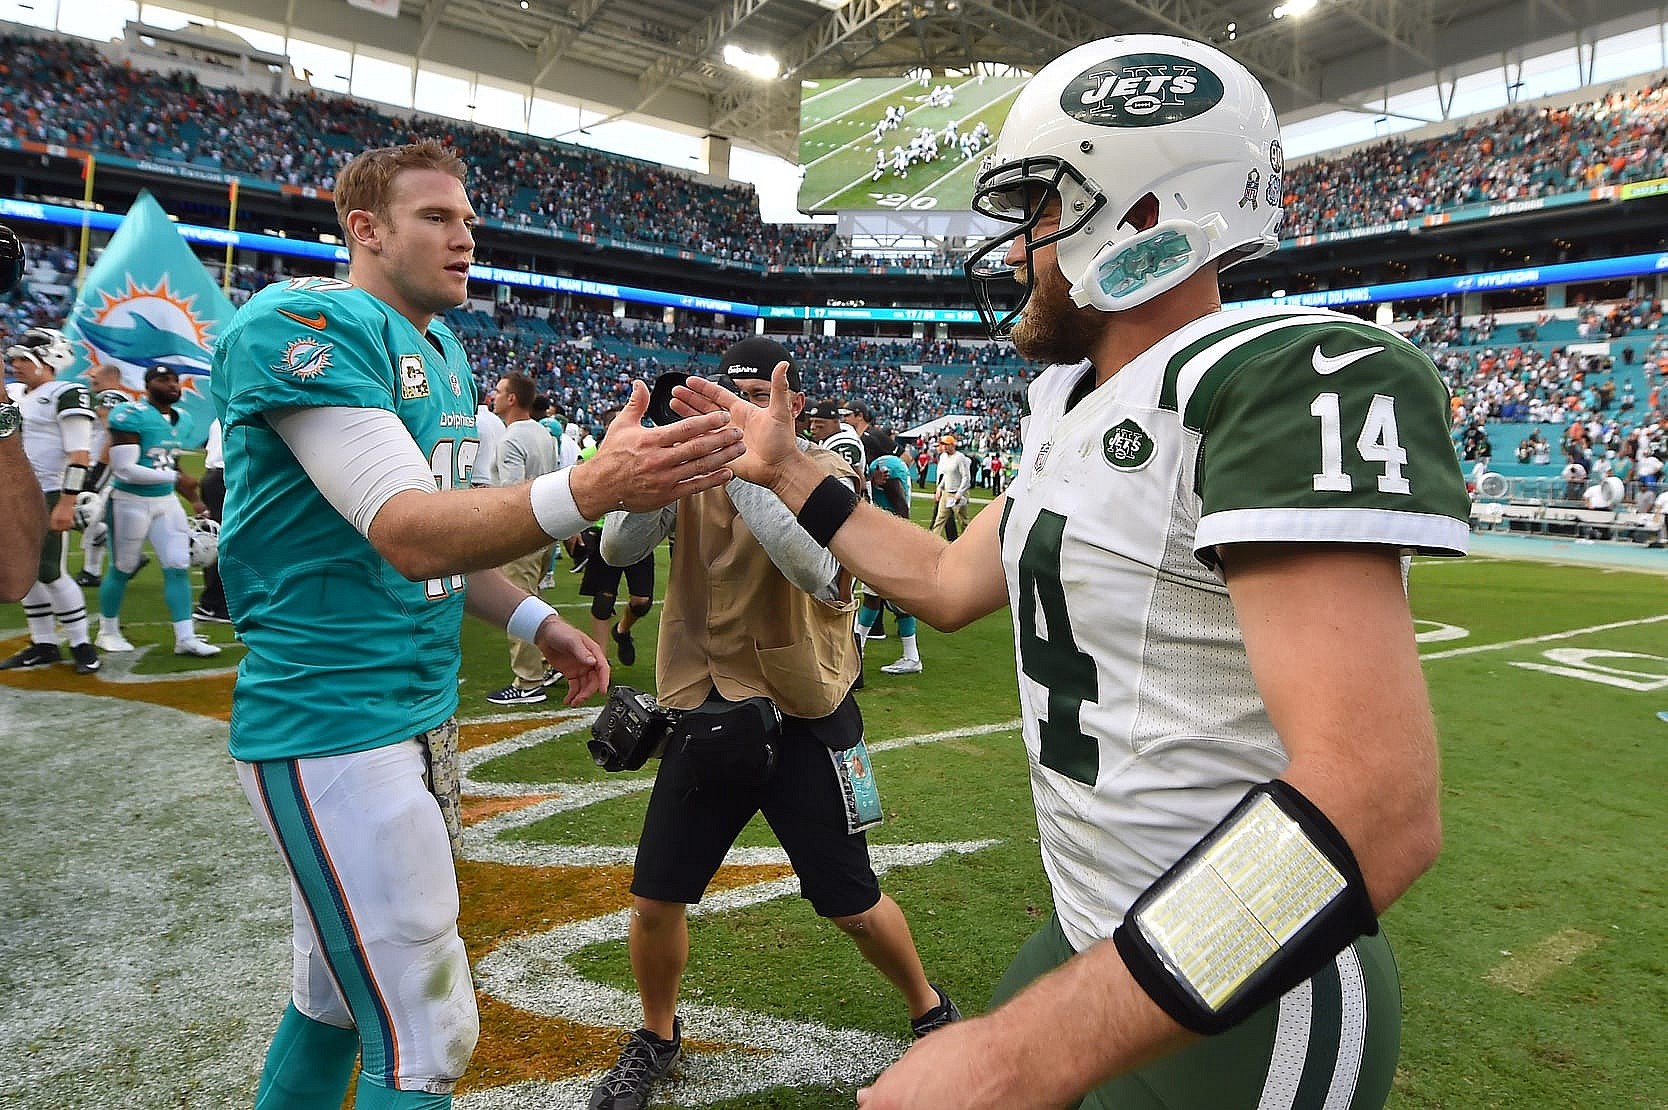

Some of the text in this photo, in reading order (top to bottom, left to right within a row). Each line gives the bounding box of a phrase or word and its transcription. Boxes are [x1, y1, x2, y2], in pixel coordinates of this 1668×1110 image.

[1081, 75, 1198, 105] JETS
[1477, 270, 1540, 287] HYUNDAI
[401, 356, 425, 388] C
[1309, 392, 1412, 496] 14
